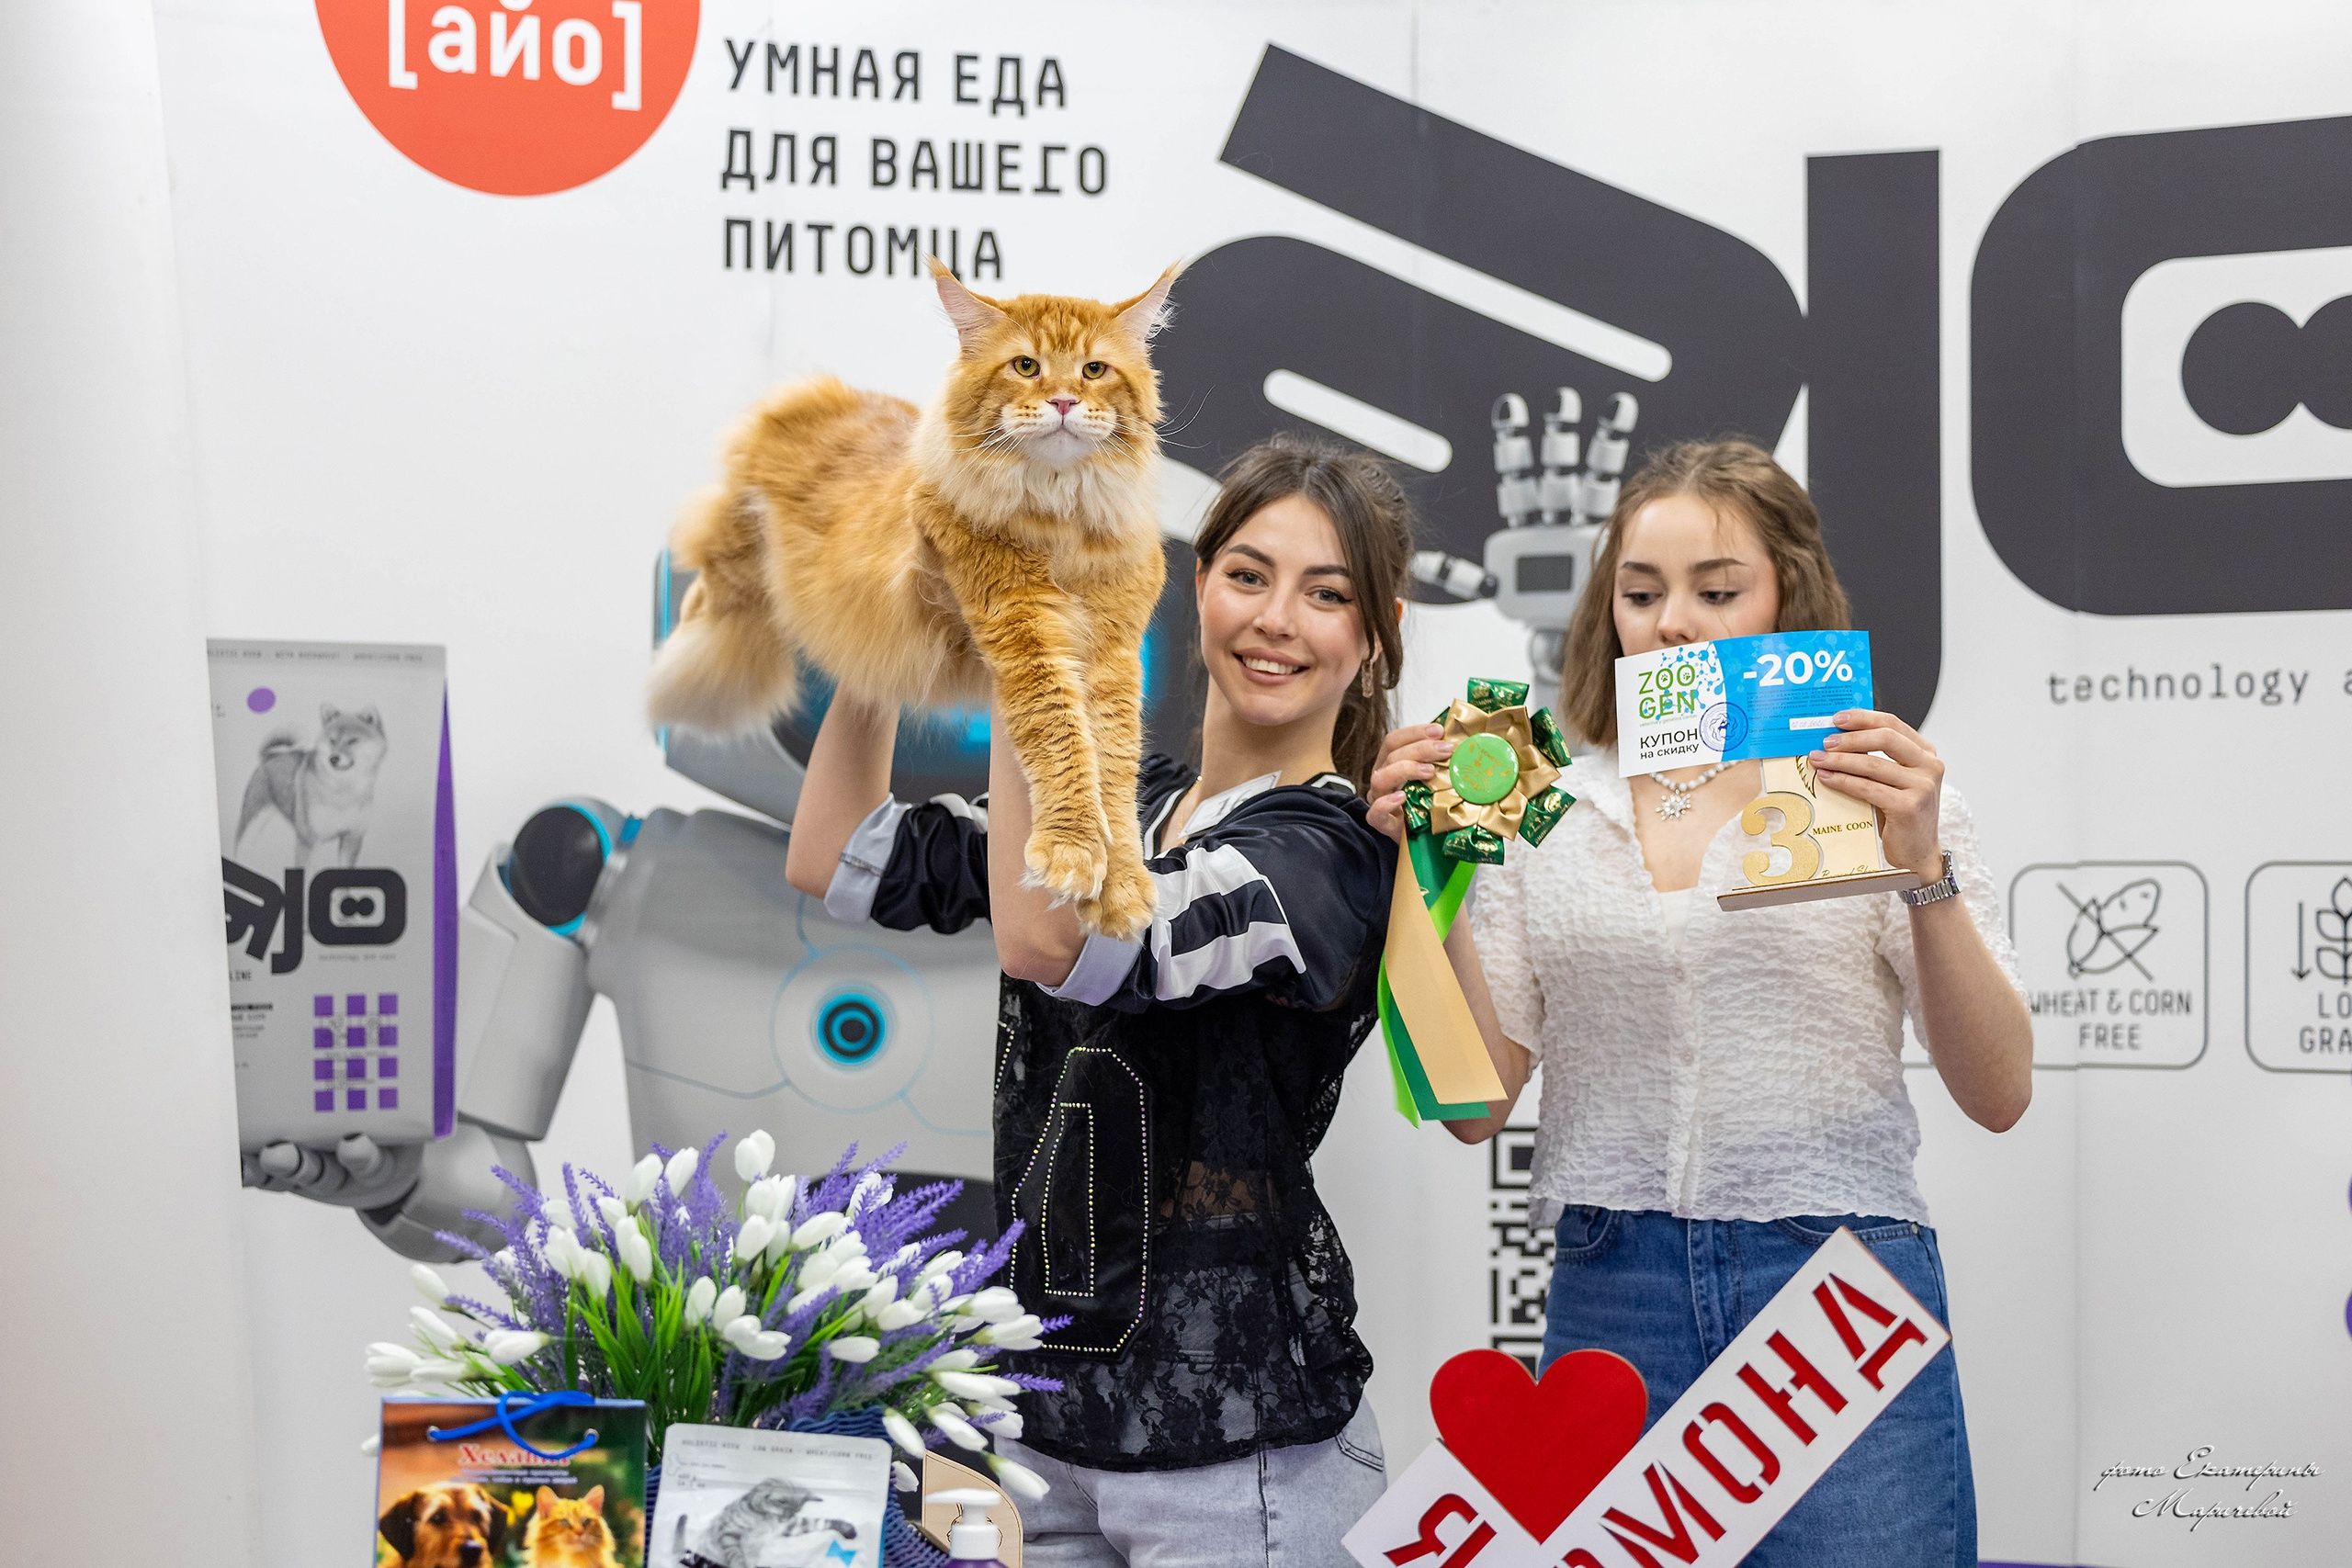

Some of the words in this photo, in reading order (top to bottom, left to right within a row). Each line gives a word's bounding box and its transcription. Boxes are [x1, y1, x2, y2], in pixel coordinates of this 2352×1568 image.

[726, 39, 919, 100] УМНАЯ
[956, 54, 1064, 117] ЕДА
[722, 129, 836, 191] ДЛЯ
[872, 139, 1105, 195] ВАШЕГО
[726, 219, 1001, 279] ПИТОМЦА
[1638, 664, 1696, 695] ZOO
[1743, 650, 1853, 687] -20%
[2047, 663, 2309, 705] technology
[1639, 689, 1696, 719] GEN
[1640, 728, 1698, 749] КУПОН
[1640, 751, 1654, 760] на
[1657, 743, 1700, 757] скидку
[1741, 791, 1821, 886] 3
[1813, 824, 1843, 835] MAINE
[1846, 820, 1874, 830] COON
[2029, 988, 2098, 1016] WHEAT
[2107, 989, 2123, 1014] &
[2129, 988, 2193, 1016] CORN
[2078, 1021, 2143, 1051] FREE
[1554, 1273, 1928, 1568] МОНД
